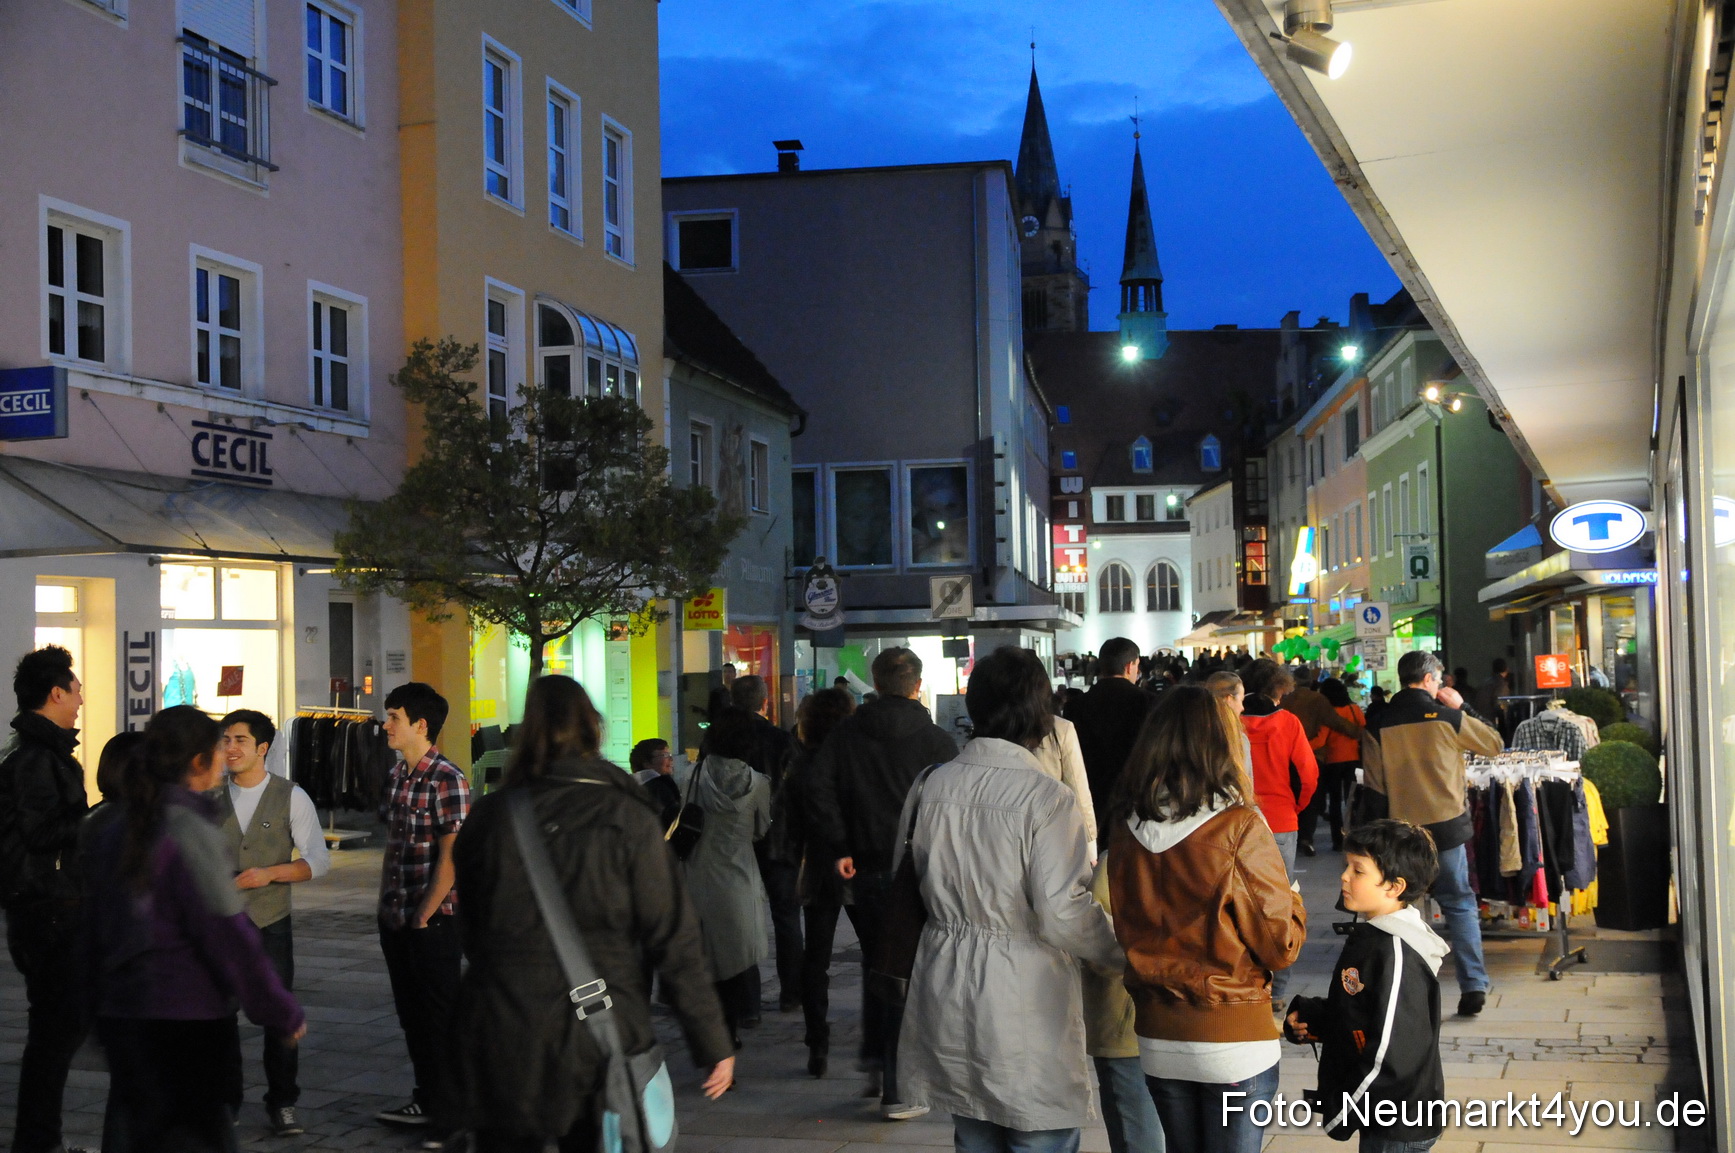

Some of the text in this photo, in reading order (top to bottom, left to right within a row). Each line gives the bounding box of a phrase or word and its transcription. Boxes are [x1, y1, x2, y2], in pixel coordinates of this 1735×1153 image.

[0, 393, 51, 412] CECIL
[191, 431, 273, 475] CECIL
[1572, 512, 1622, 541] T
[1055, 572, 1087, 584] WITT
[688, 610, 720, 620] LOTTO
[1364, 626, 1381, 634] ZONE
[129, 631, 151, 733] ECIL
